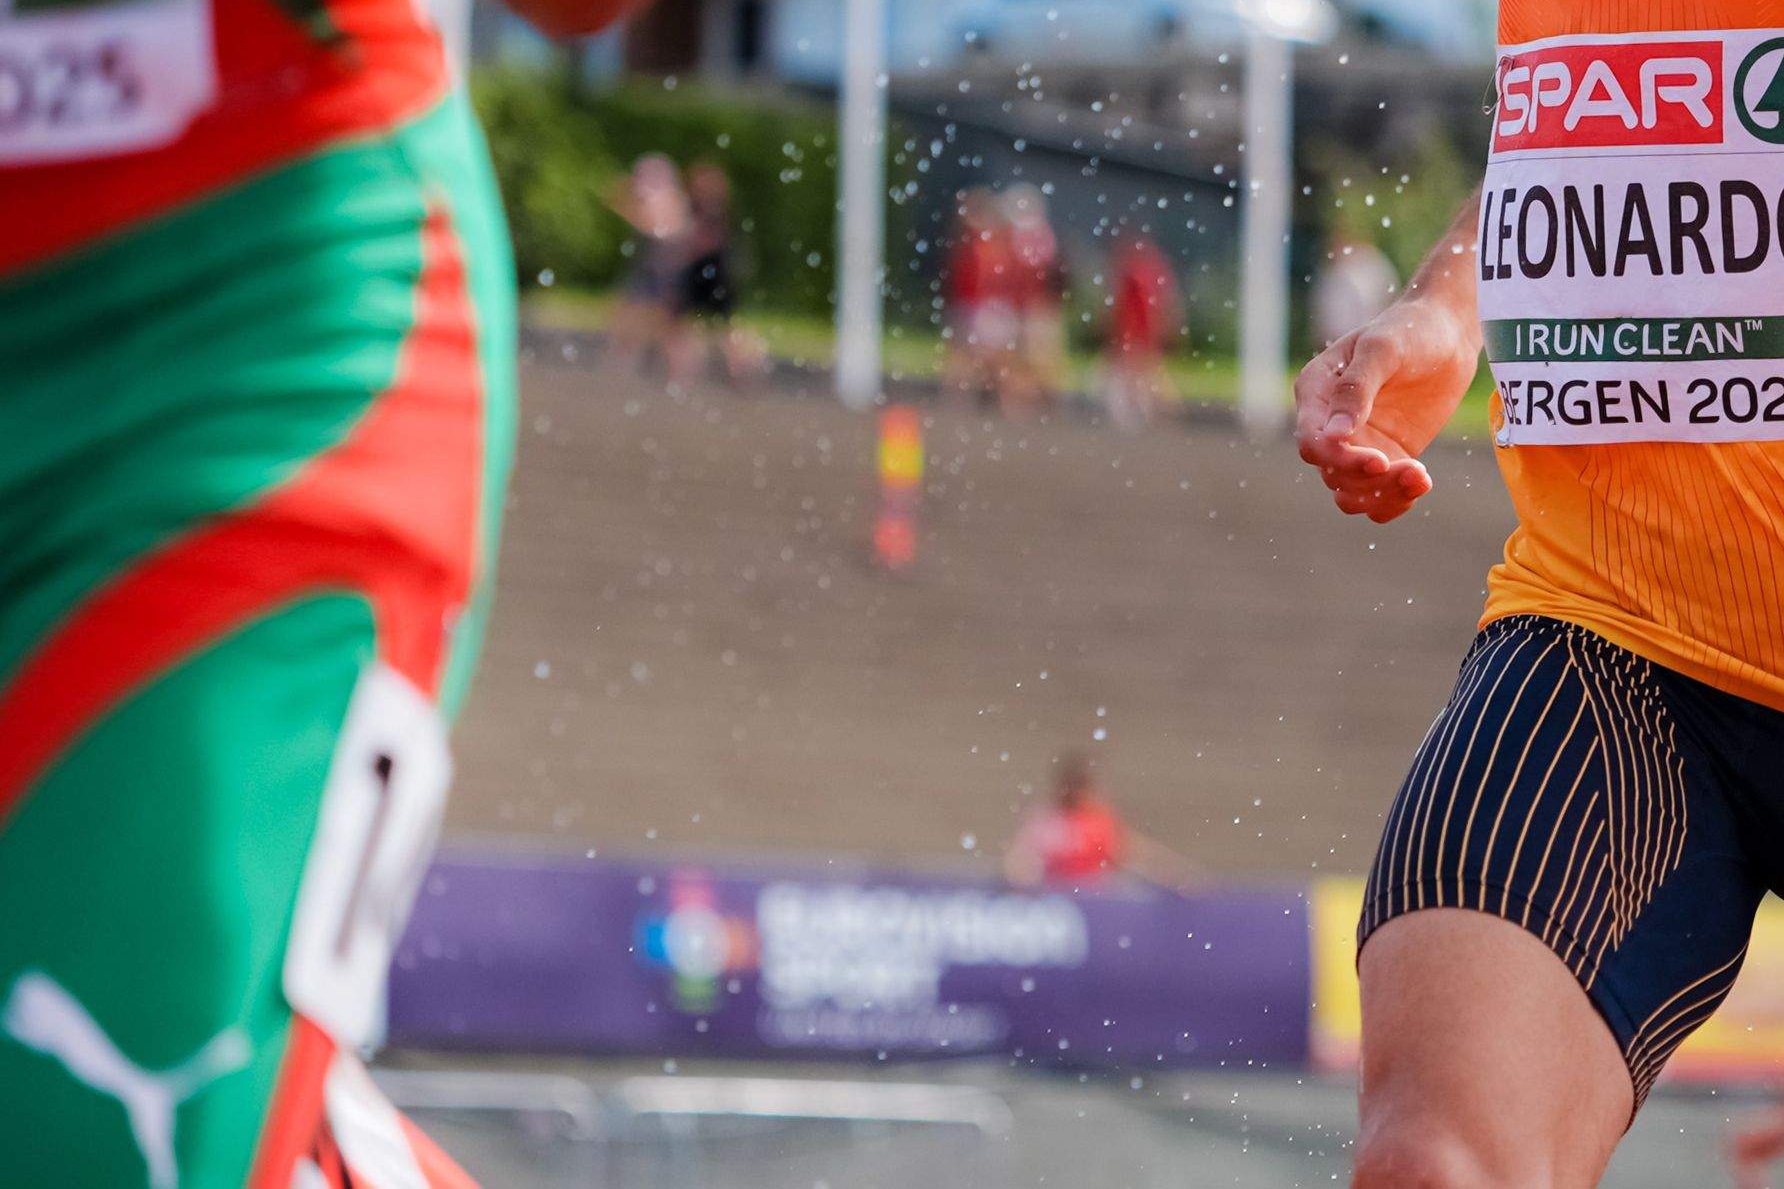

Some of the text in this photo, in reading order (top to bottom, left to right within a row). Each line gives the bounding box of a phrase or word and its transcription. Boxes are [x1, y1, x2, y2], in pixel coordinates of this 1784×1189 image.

[1499, 56, 1714, 137] SPAR
[1528, 323, 1605, 356] RUN
[1500, 379, 1671, 426] BERGEN
